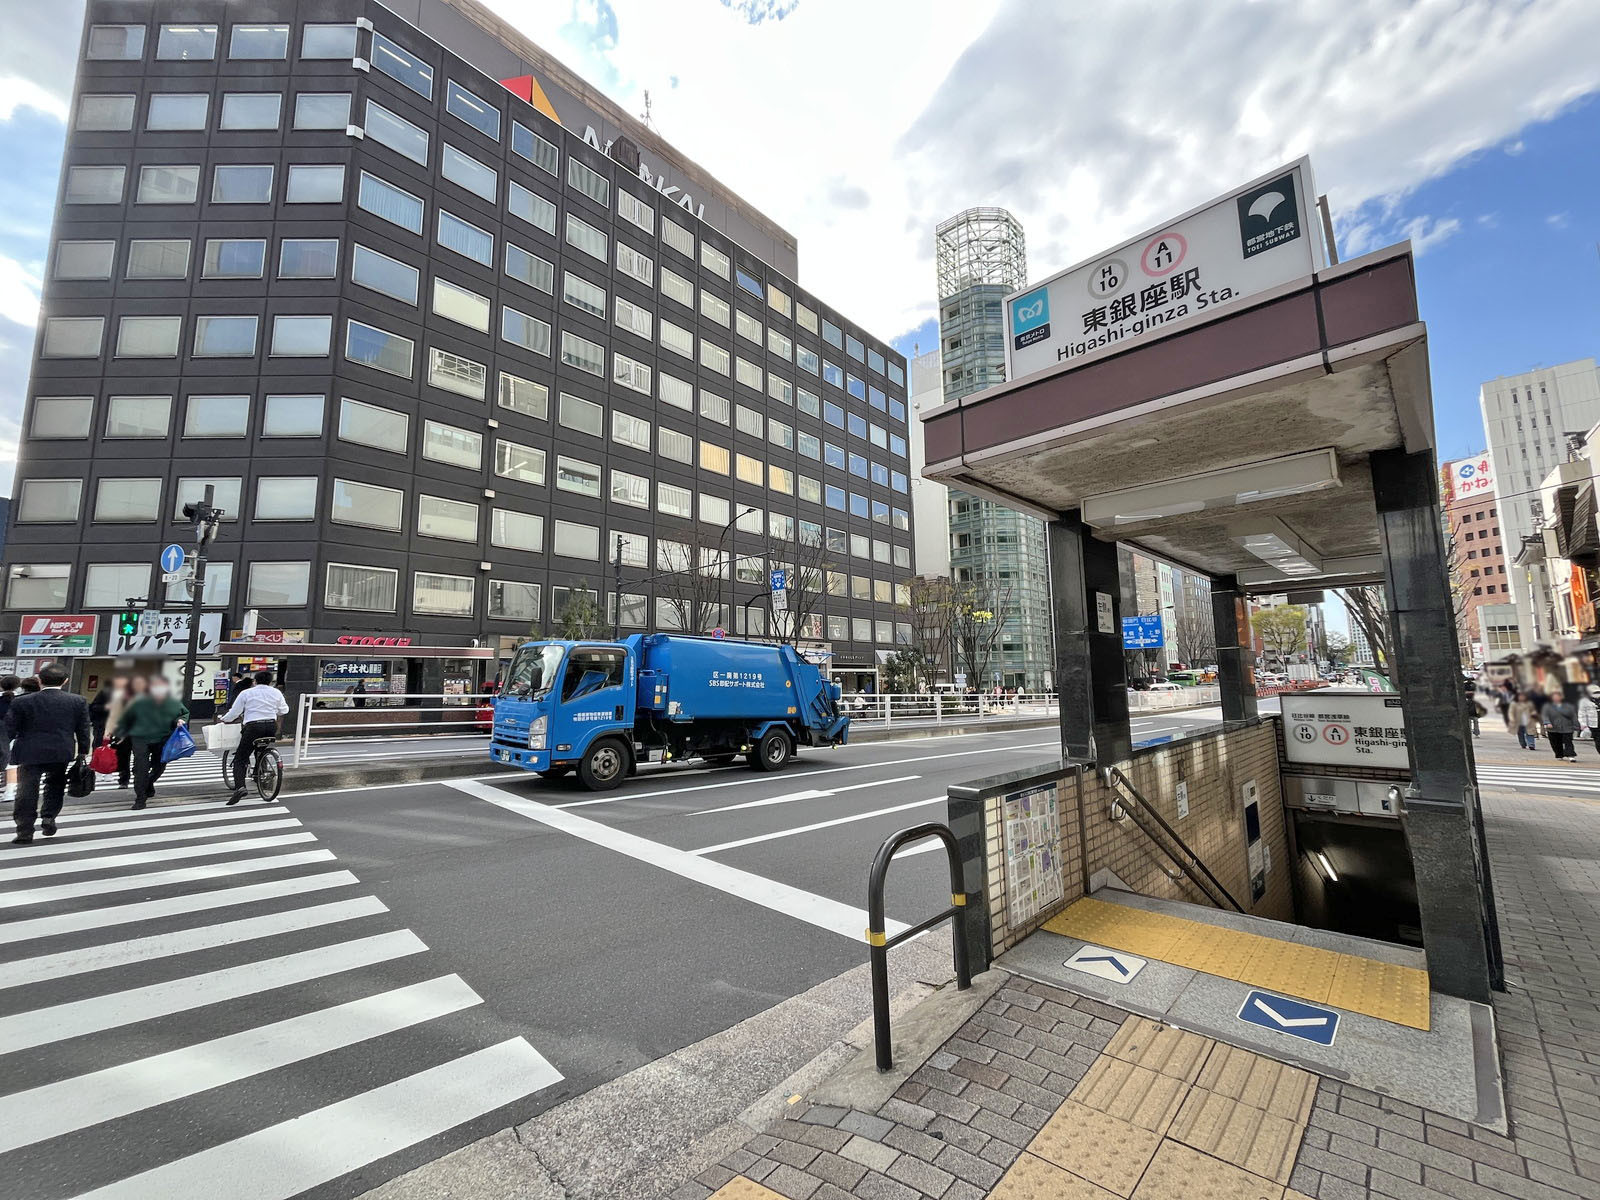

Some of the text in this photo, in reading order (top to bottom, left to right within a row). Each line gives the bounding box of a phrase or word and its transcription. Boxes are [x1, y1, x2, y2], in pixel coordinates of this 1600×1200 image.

[1246, 221, 1295, 247] 都営地下鉄
[1247, 229, 1295, 253] TOEI SUBWAY
[1156, 241, 1169, 255] A
[1154, 252, 1173, 268] 11
[1101, 265, 1113, 279] H
[1099, 275, 1119, 292] 10
[1081, 266, 1201, 335] 東銀座駅
[1056, 285, 1240, 363] Higashi-ginza Sta.
[1020, 328, 1045, 342] 東京メトロ
[1461, 477, 1493, 493] かね
[50, 621, 84, 629] NIPPON
[116, 631, 212, 651] ルノアール
[255, 634, 282, 643] 宝くじ
[337, 663, 369, 674] 千社札
[708, 679, 765, 689] SBS即配サポート株式会社
